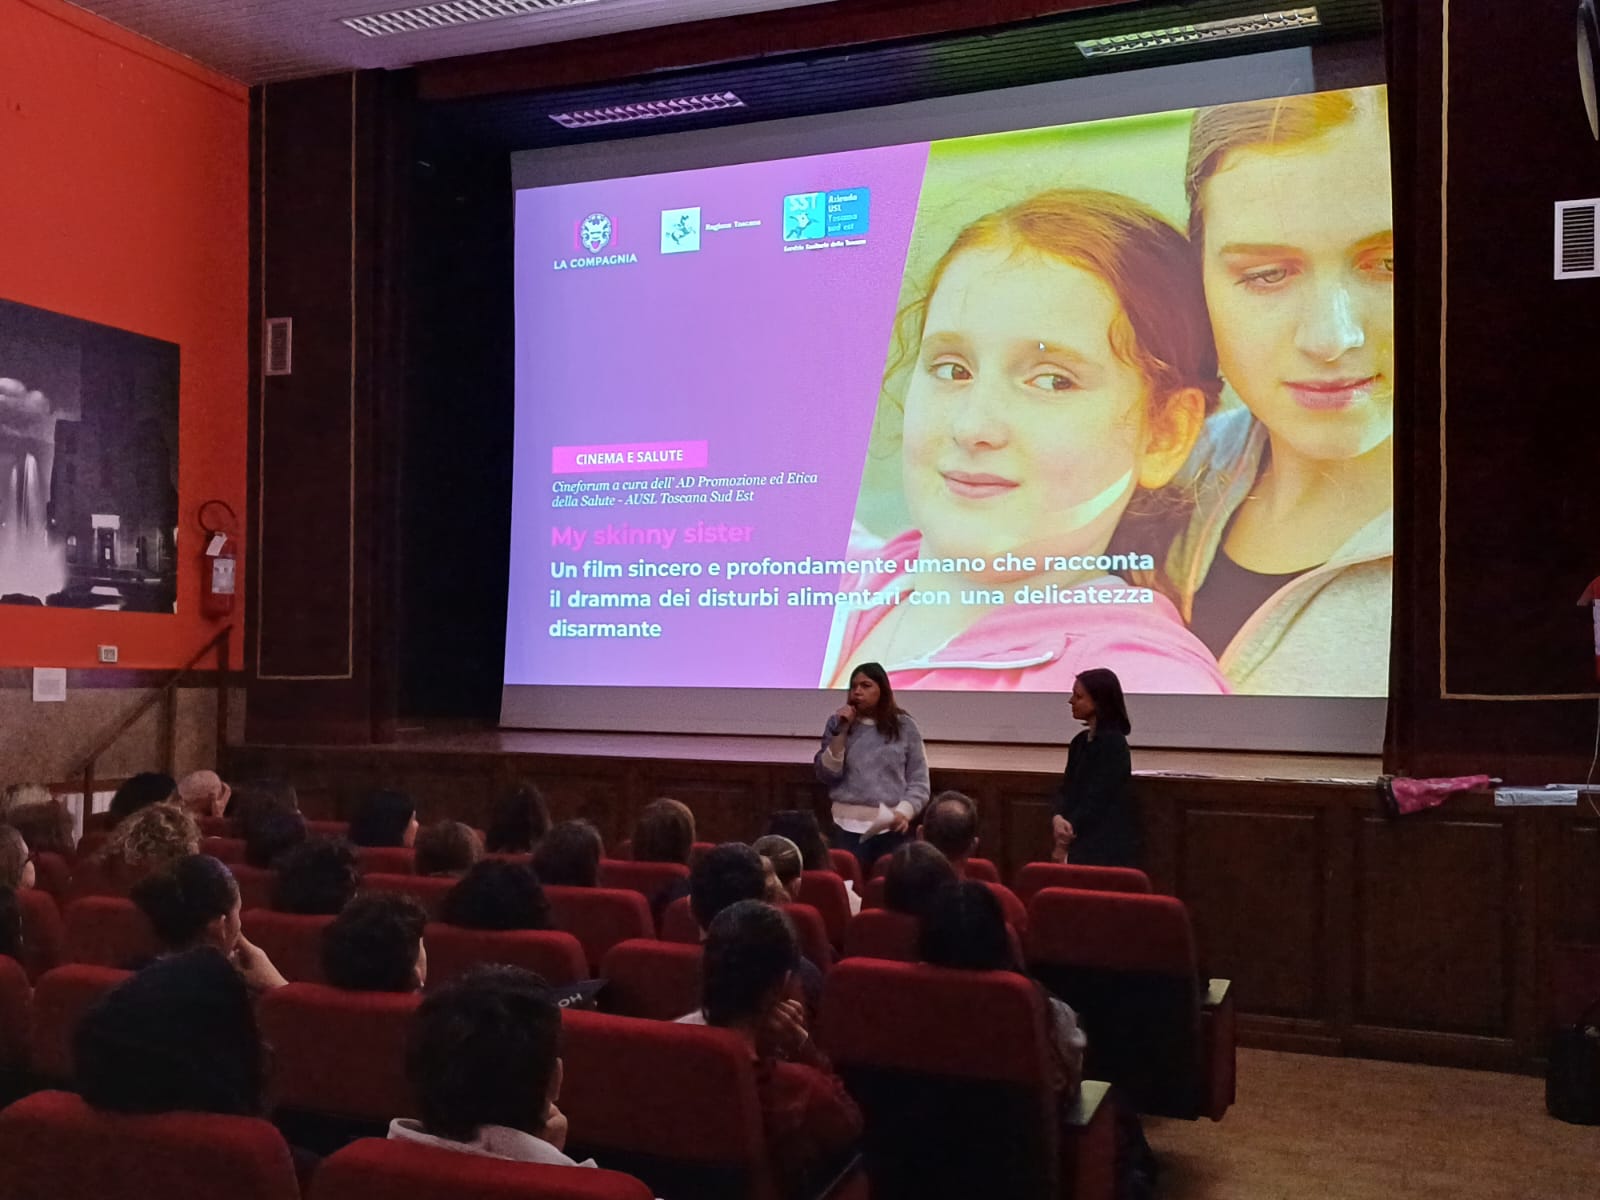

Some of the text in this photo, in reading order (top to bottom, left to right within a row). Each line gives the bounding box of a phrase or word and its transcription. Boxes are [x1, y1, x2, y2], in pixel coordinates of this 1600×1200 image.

[553, 253, 638, 270] LA COMPAGNIA
[576, 449, 684, 466] CINEMA E SALUTE
[552, 480, 610, 495] Cineforum
[612, 482, 620, 491] a
[622, 481, 648, 491] cura
[676, 475, 695, 488] AD
[698, 474, 767, 487] Promozione
[770, 472, 784, 485] ed
[787, 471, 818, 485] Etica
[552, 495, 578, 508] della
[580, 494, 616, 507] Salute
[624, 492, 657, 506] AUSL
[660, 490, 708, 504] Toscana
[710, 489, 732, 503] Sud
[736, 489, 754, 502] Est
[551, 521, 754, 550] My skinny sister
[551, 551, 1155, 580] Un film sincero e profondamente umano che racconta
[550, 585, 1154, 608] il dramma dei disturbi alimentari con una delicatezza
[549, 619, 662, 637] disarmante
